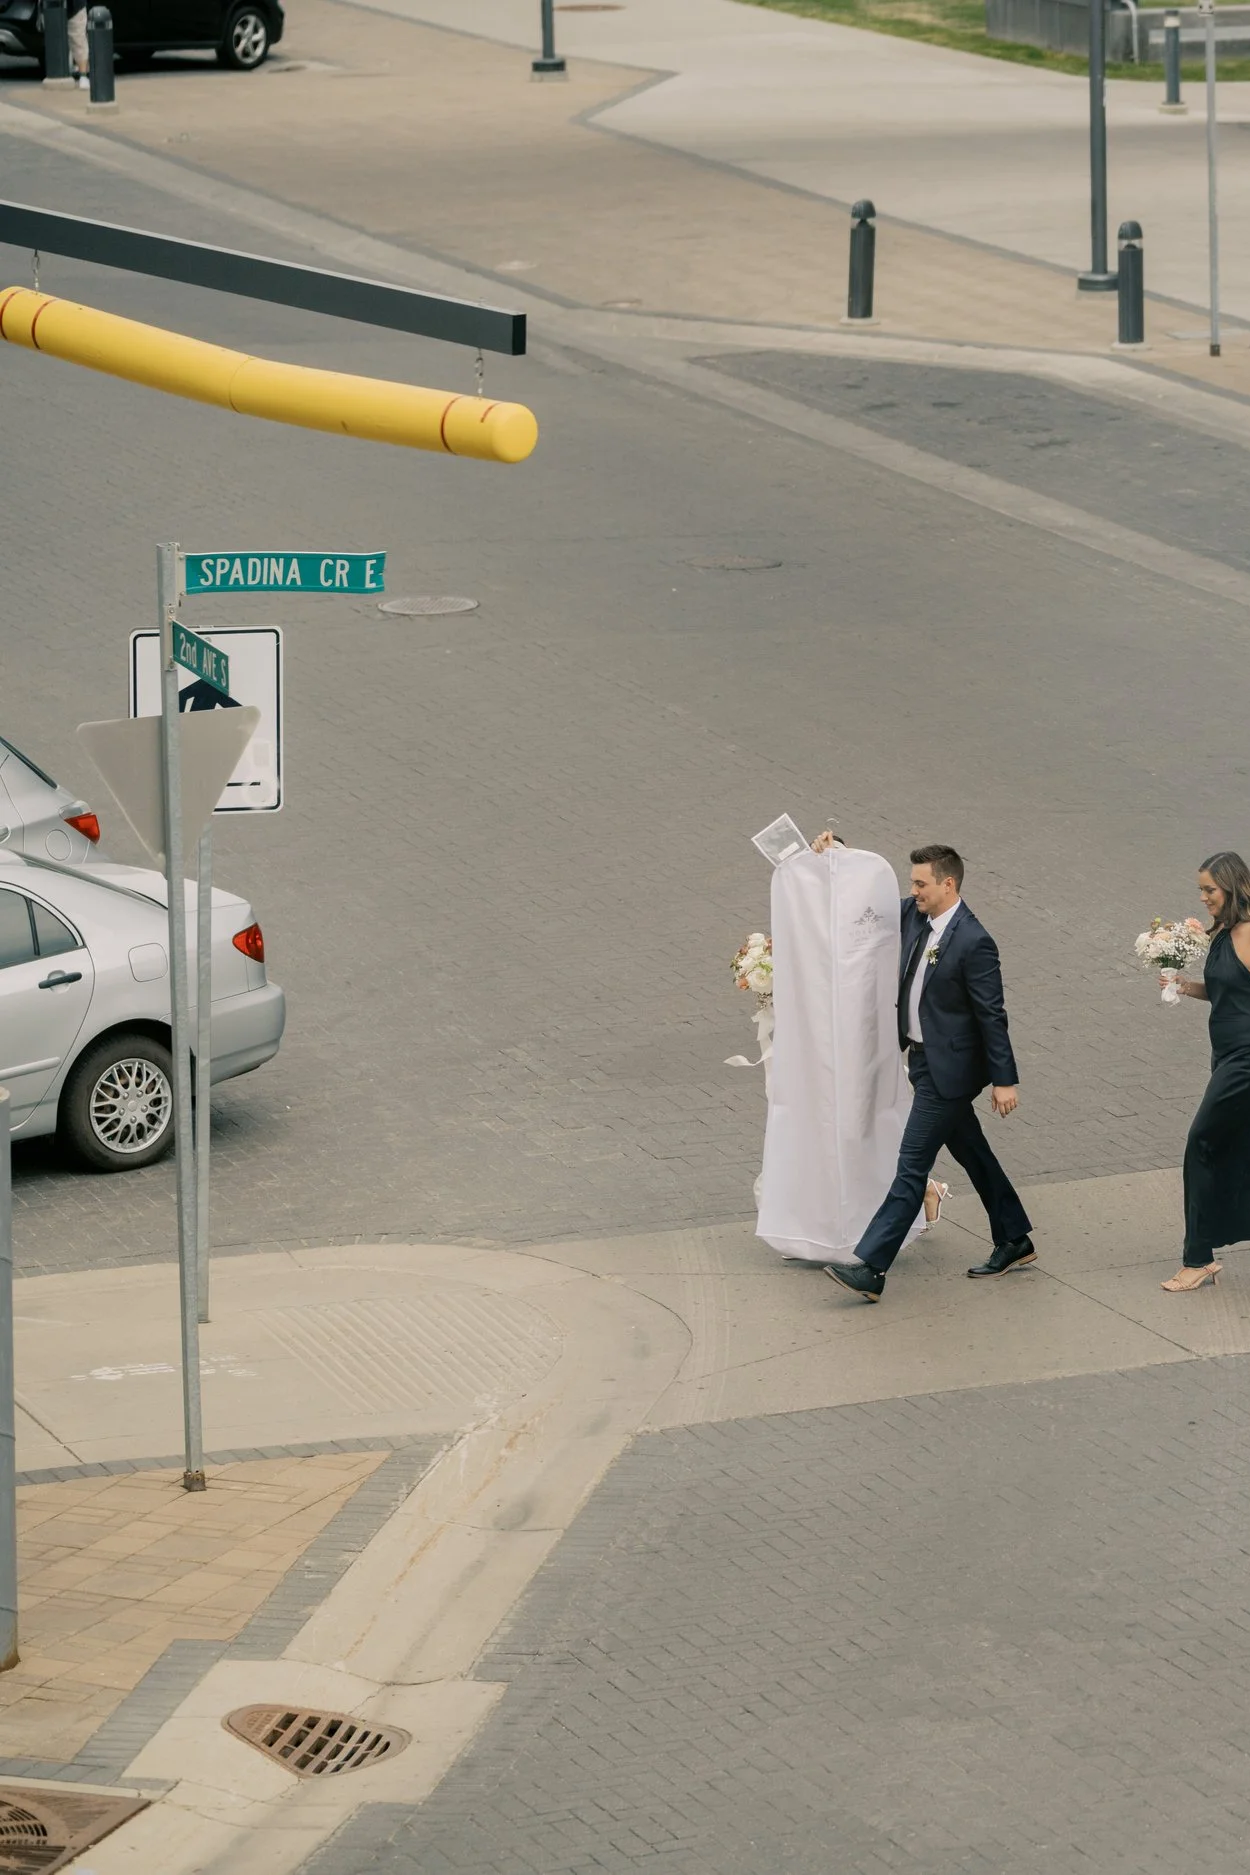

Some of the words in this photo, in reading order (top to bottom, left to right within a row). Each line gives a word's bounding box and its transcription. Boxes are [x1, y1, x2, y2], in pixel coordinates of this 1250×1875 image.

[200, 558, 301, 586] SPADINA
[319, 559, 349, 587] CR
[365, 560, 377, 588] E
[179, 633, 197, 668] 2nd
[203, 646, 217, 681] AVE
[220, 658, 227, 687] S
